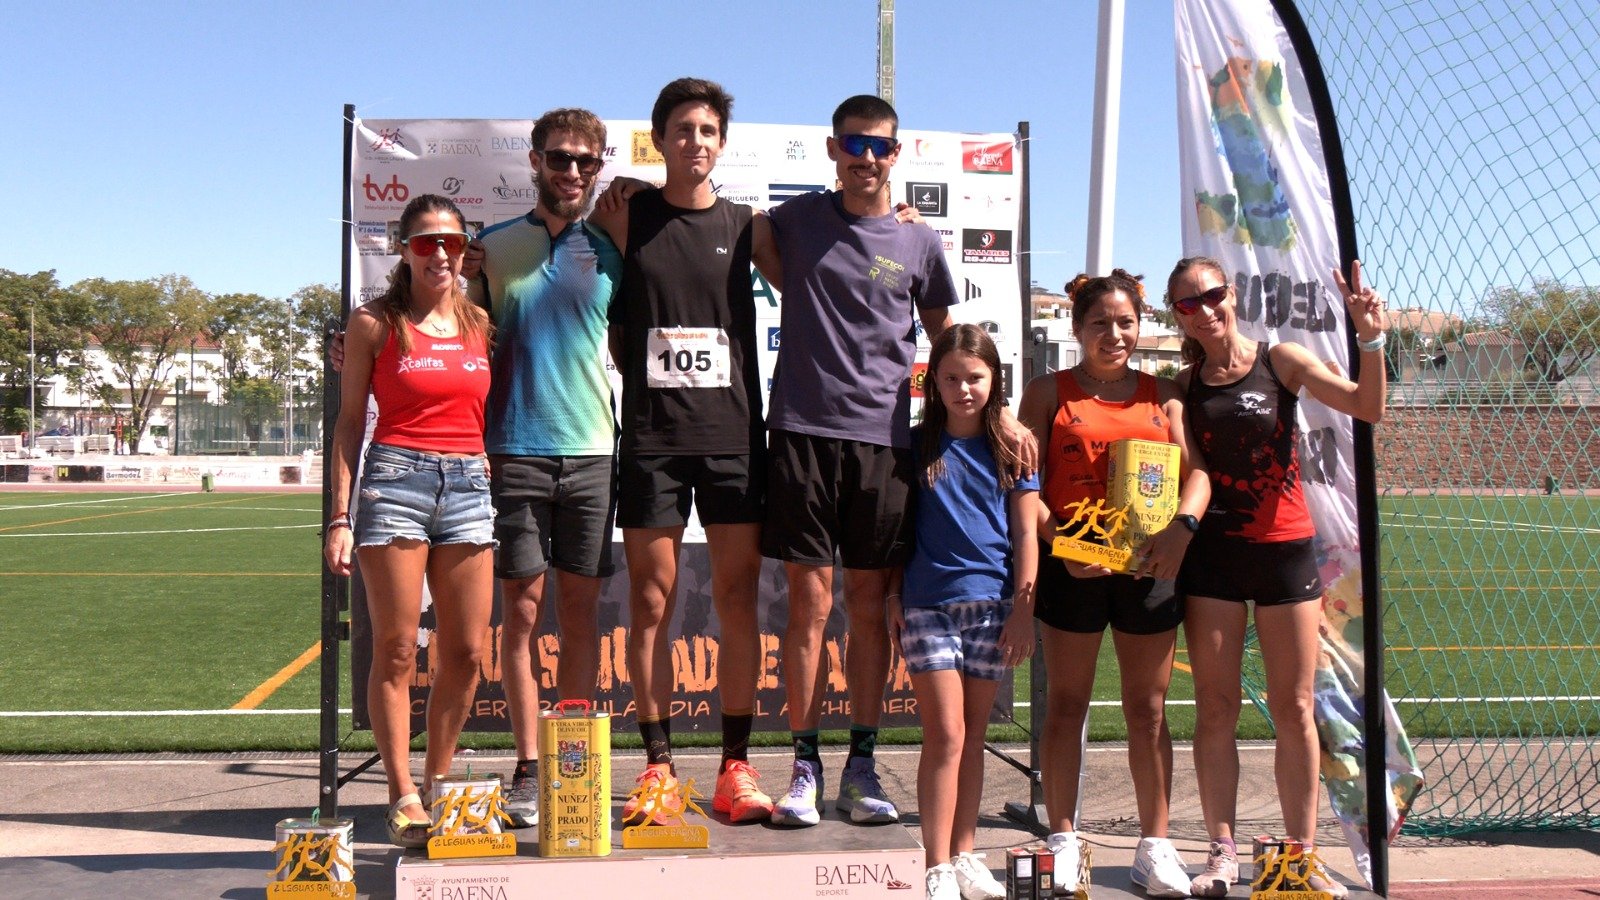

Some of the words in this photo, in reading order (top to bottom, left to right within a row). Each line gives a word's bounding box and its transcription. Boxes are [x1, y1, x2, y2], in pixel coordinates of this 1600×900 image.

[492, 136, 531, 150] BAEN
[441, 143, 482, 157] BAENA
[452, 197, 484, 205] ARRO
[408, 357, 444, 368] califas
[657, 350, 712, 372] 105
[1134, 512, 1162, 524] NUÑEZ
[1142, 524, 1154, 533] DE
[1097, 547, 1126, 561] BAENA
[670, 700, 710, 717] DIA
[557, 793, 588, 804] NUÑEZ
[566, 806, 579, 814] DE
[557, 816, 589, 825] PRADO
[442, 837, 476, 847] LEGUAS
[815, 863, 895, 886] BAENA
[274, 884, 280, 892] 2
[282, 884, 315, 892] LEGUAS
[441, 885, 508, 900] BAENA
